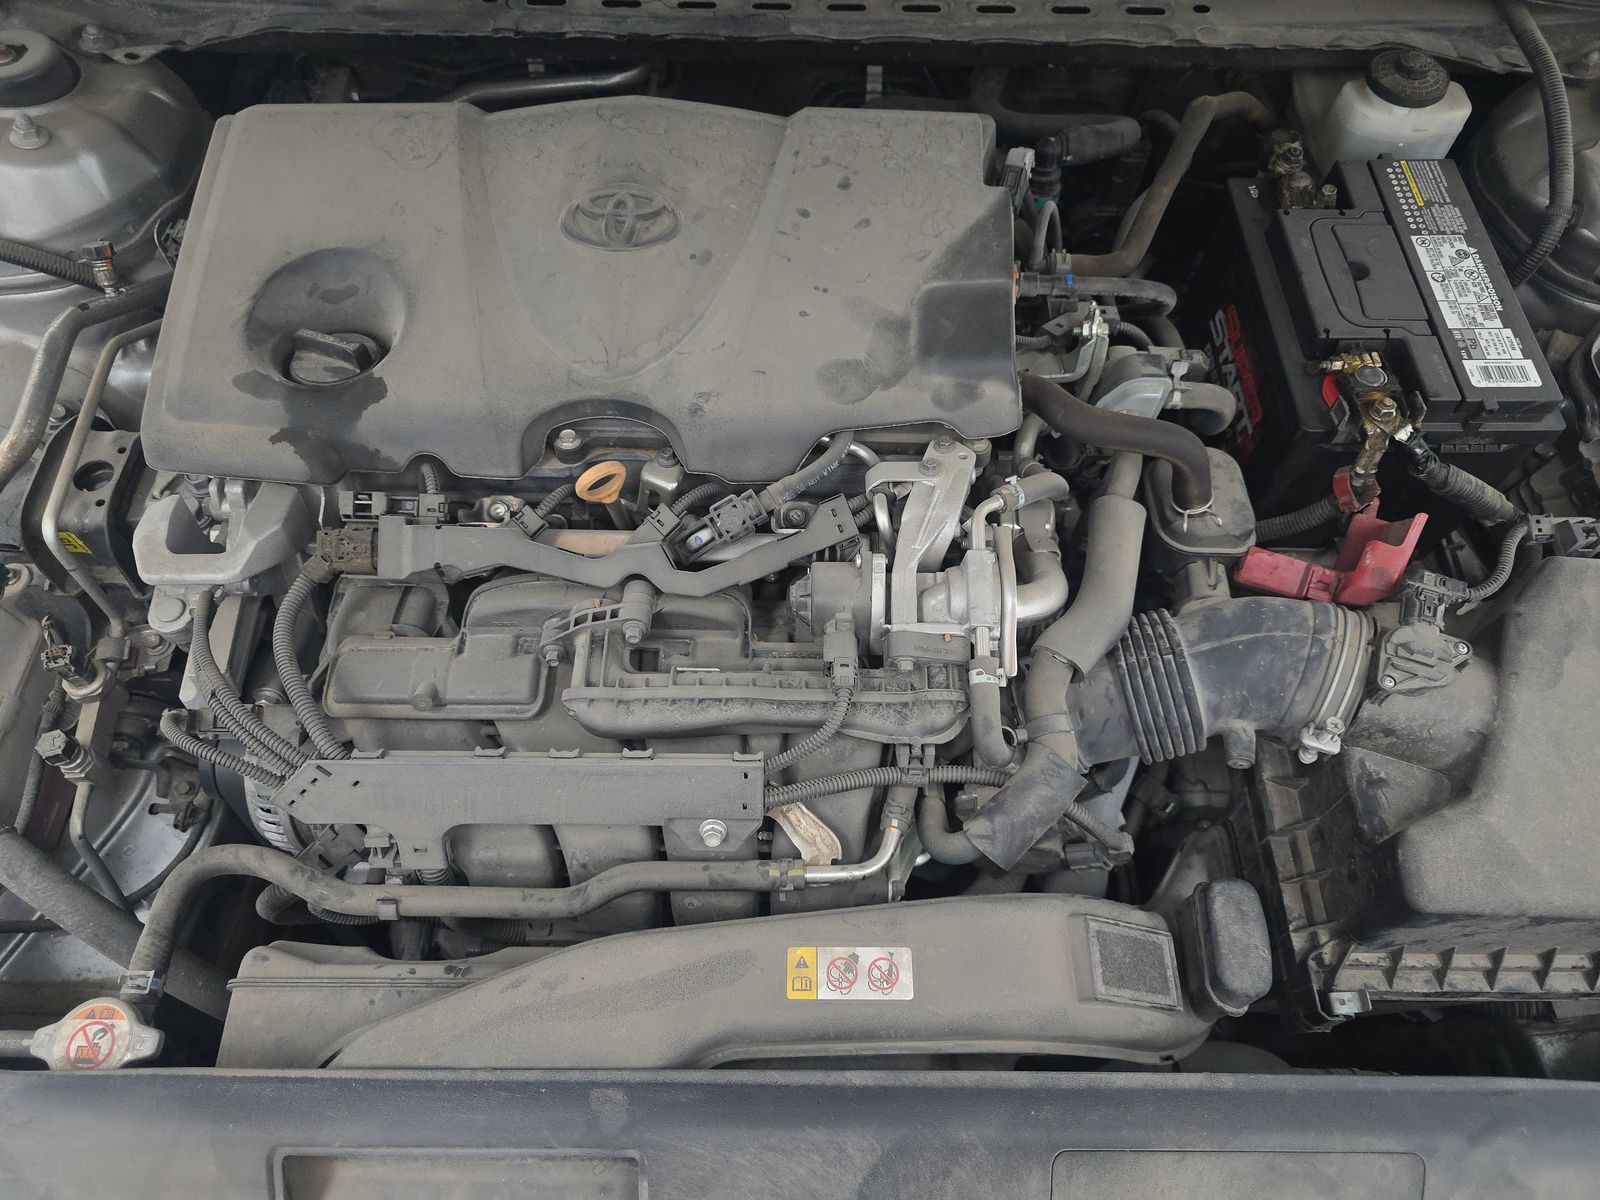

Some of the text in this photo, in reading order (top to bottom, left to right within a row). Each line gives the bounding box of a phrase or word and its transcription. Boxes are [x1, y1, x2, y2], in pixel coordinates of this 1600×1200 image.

[1472, 253, 1504, 312] DANGER/POISON
[1466, 337, 1478, 350] Pb
[1209, 309, 1254, 438] START
